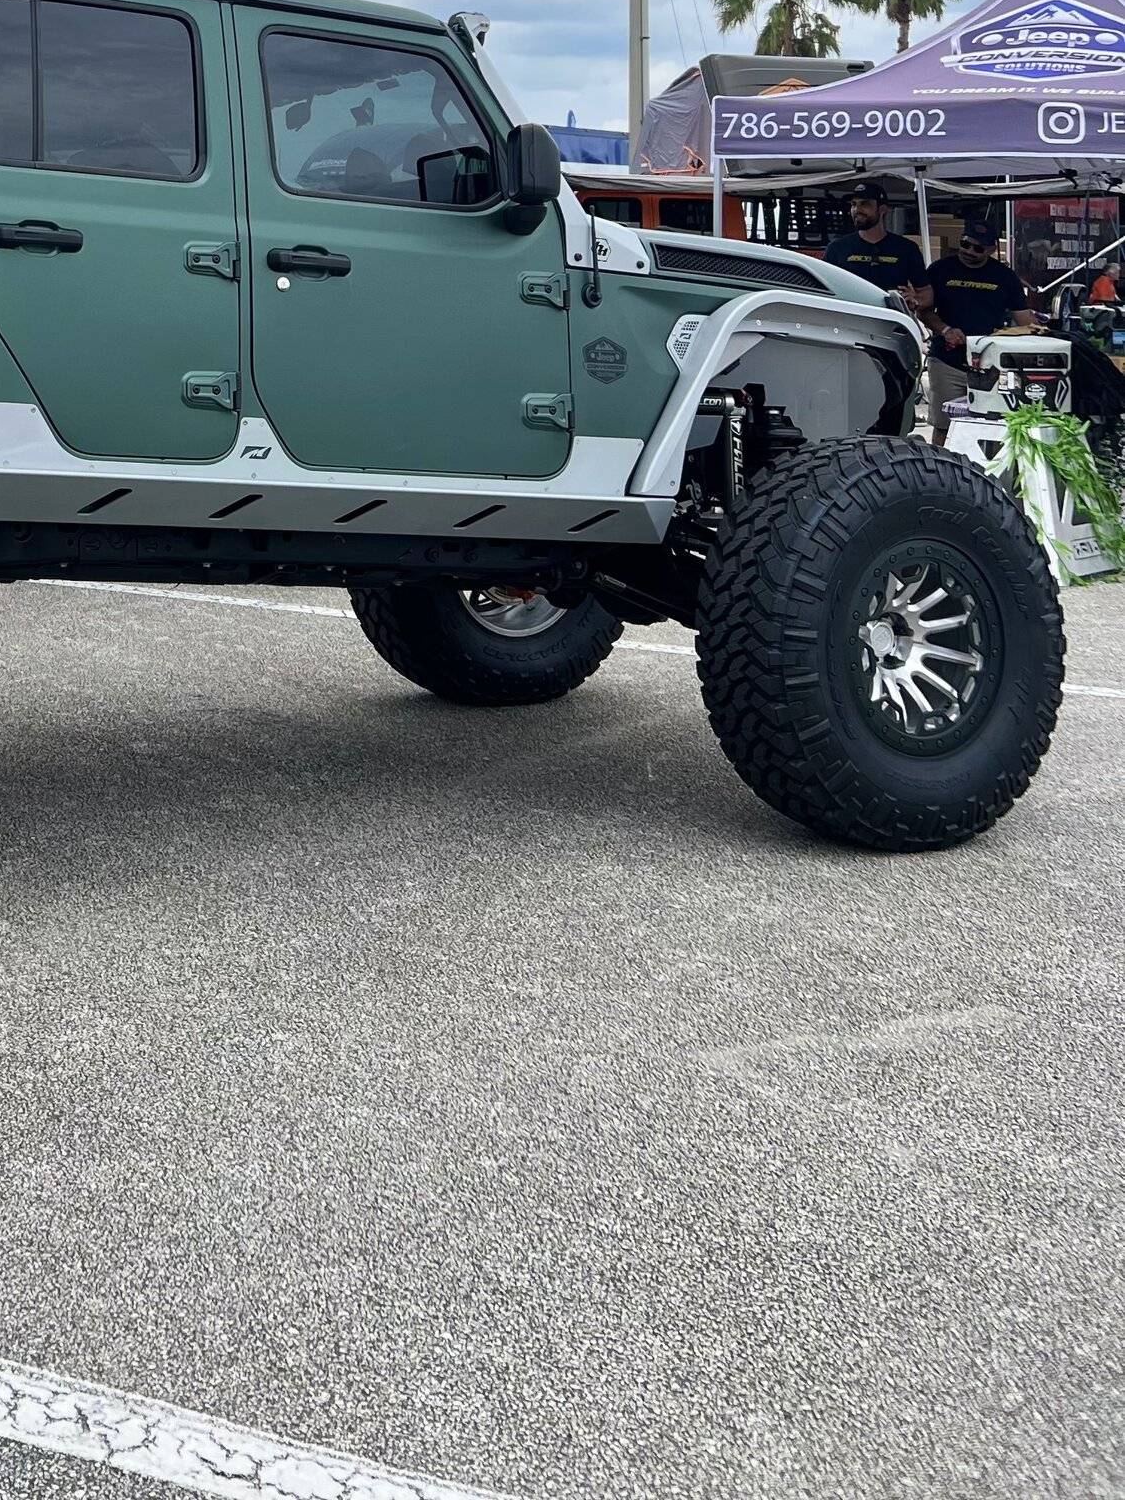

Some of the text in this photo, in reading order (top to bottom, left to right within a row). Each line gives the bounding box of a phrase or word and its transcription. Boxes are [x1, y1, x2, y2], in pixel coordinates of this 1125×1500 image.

[1005, 28, 1090, 48] Jeep
[993, 62, 1086, 73] SOLUTIONS
[949, 87, 1016, 95] DREAM
[1042, 87, 1074, 95] WE
[721, 108, 947, 139] 786-569-9002
